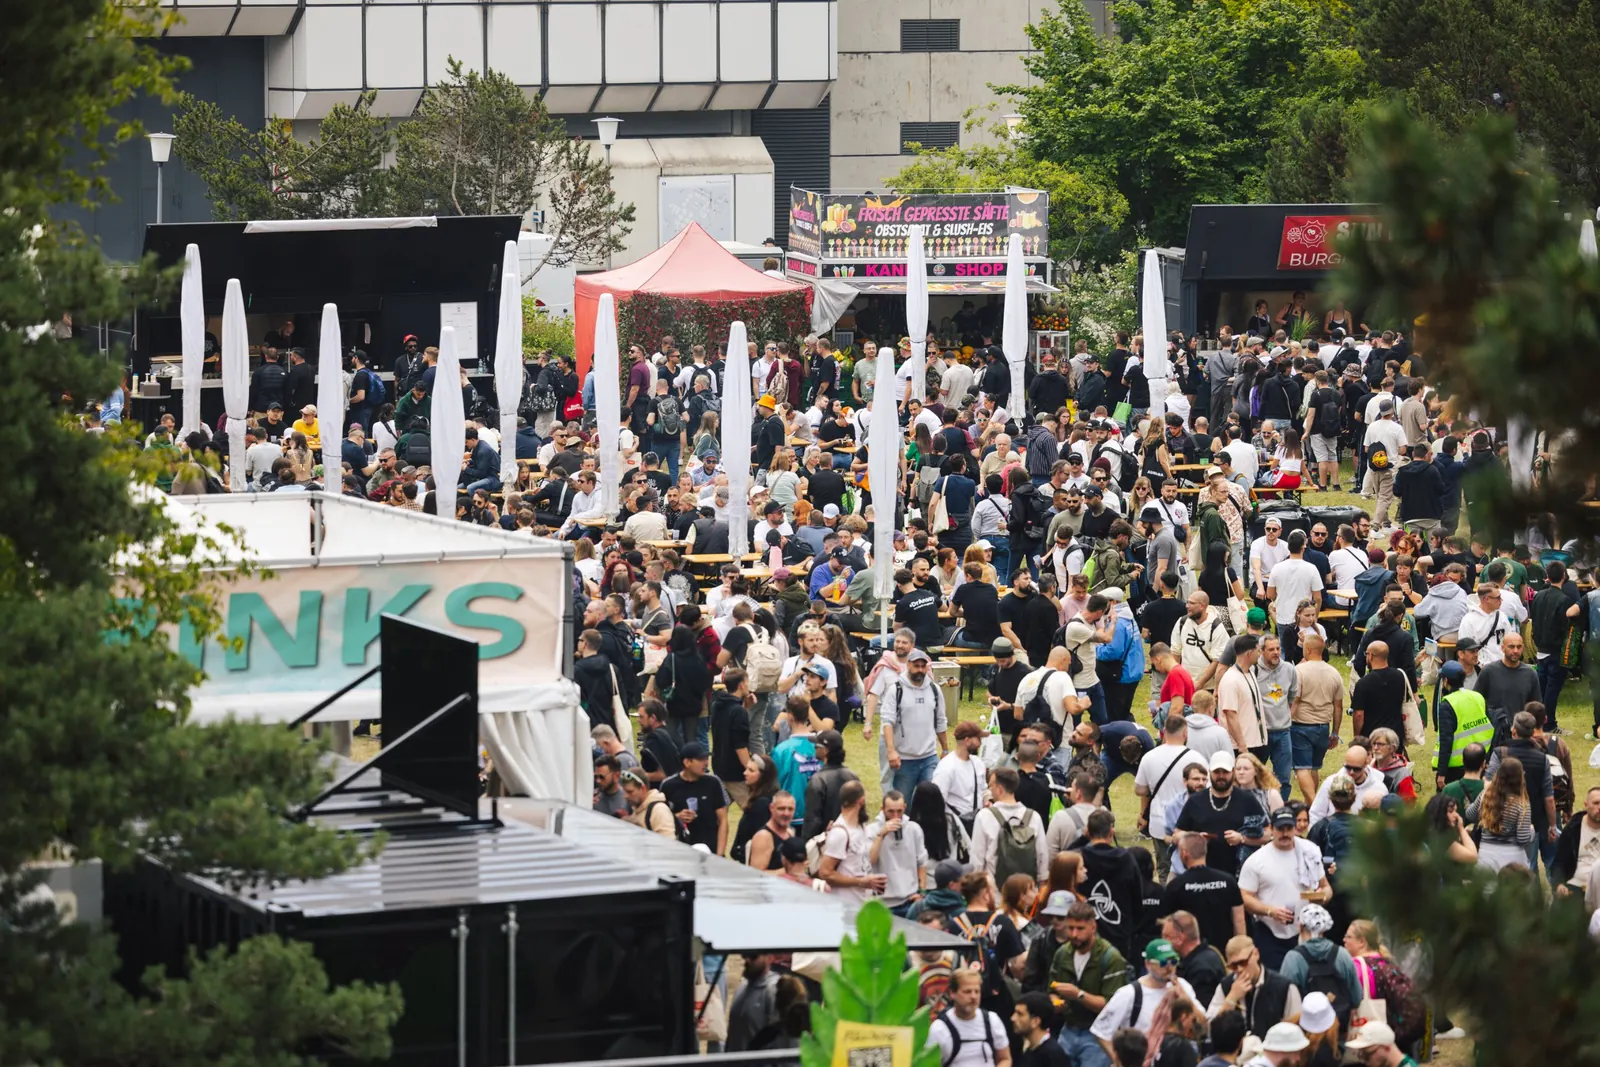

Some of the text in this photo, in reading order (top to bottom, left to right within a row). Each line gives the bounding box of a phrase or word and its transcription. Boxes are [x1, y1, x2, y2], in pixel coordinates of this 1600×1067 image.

[857, 202, 1010, 222] FRISCH GEPRESSTE SÄFTE
[875, 222, 994, 237] OBSTSAAT & SLUSH-EIS
[955, 263, 1005, 276] SHOP
